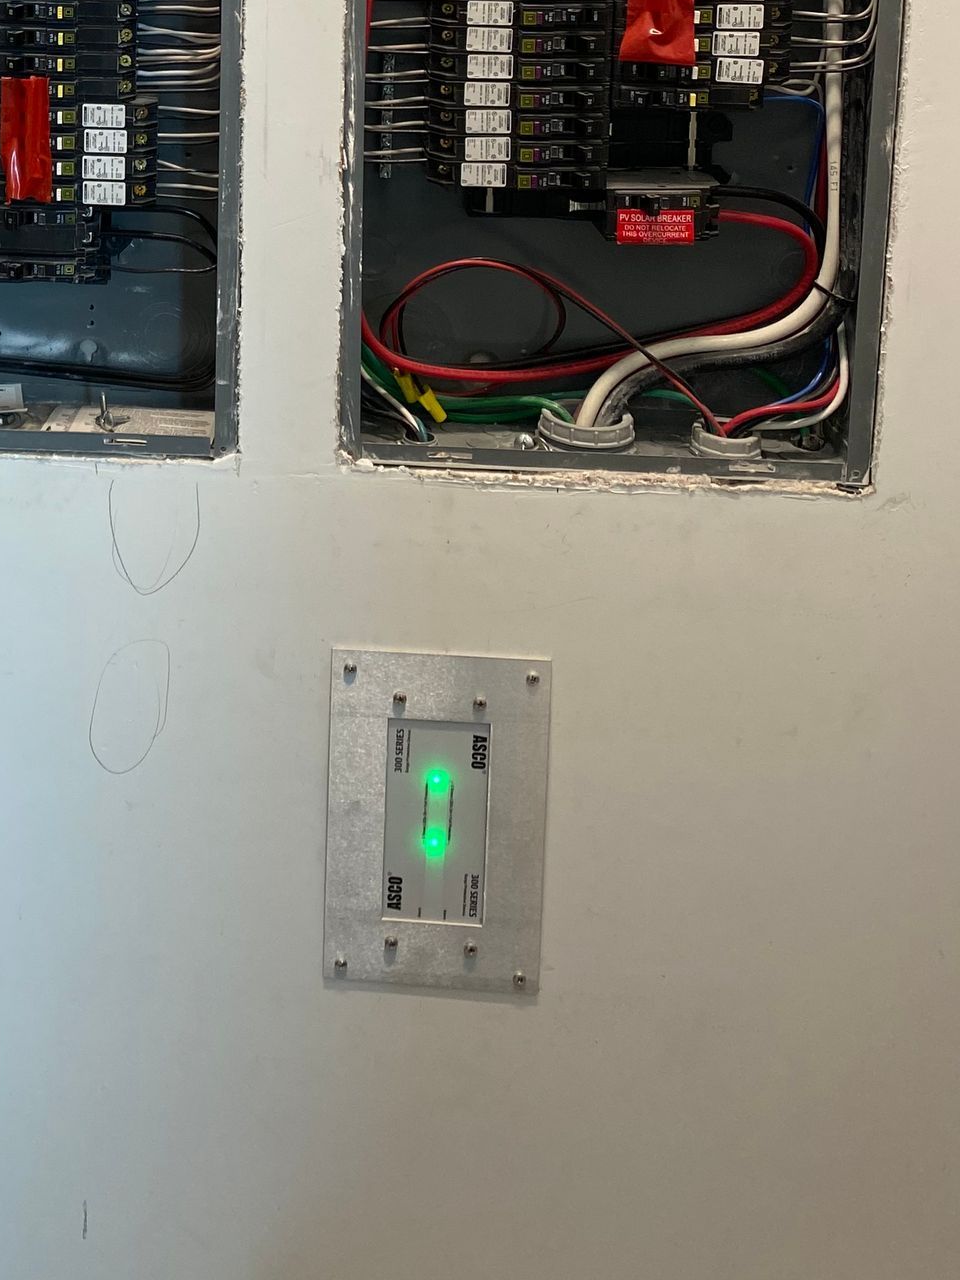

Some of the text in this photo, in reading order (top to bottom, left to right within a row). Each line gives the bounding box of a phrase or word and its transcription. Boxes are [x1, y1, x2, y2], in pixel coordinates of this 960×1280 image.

[394, 729, 404, 773] 300 SERIES
[471, 734, 487, 770] ASCO
[387, 875, 403, 911] ASCO
[469, 874, 479, 918] 300 SERIES
